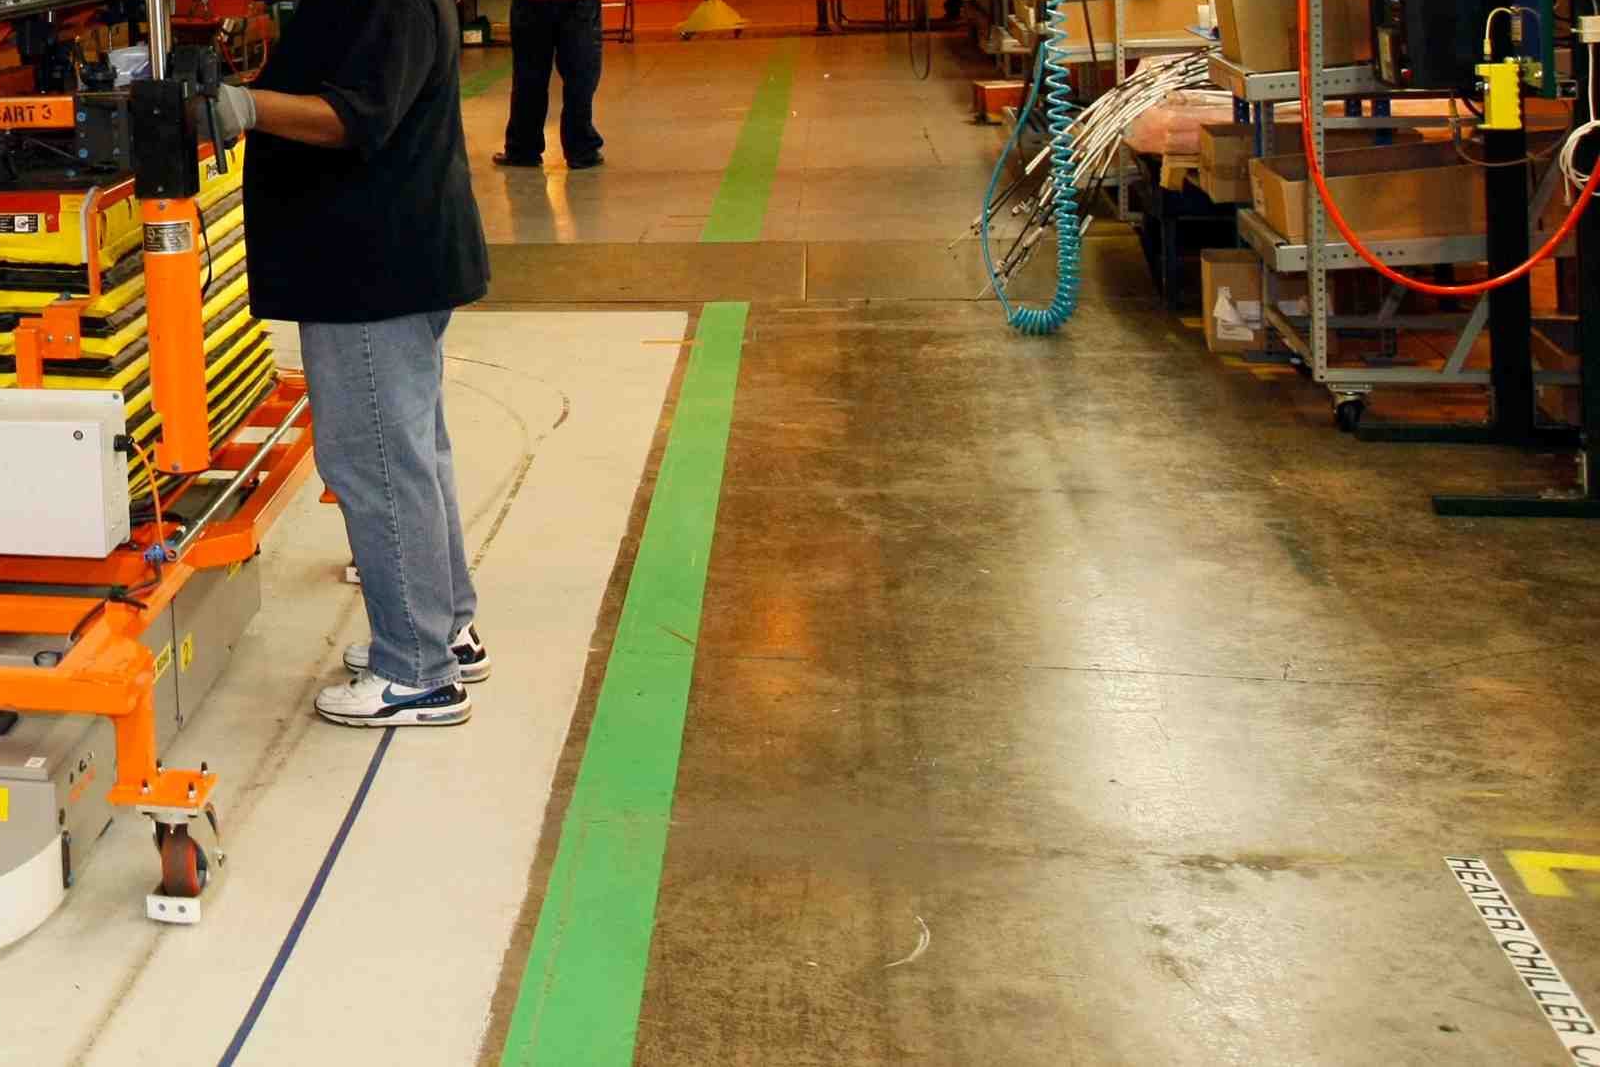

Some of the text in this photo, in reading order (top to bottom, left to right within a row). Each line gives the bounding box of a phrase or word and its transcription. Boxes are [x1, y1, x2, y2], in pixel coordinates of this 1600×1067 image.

[42, 104, 52, 120] 3
[1446, 856, 1526, 933] HEATER
[1501, 940, 1595, 1035] CHILLER
